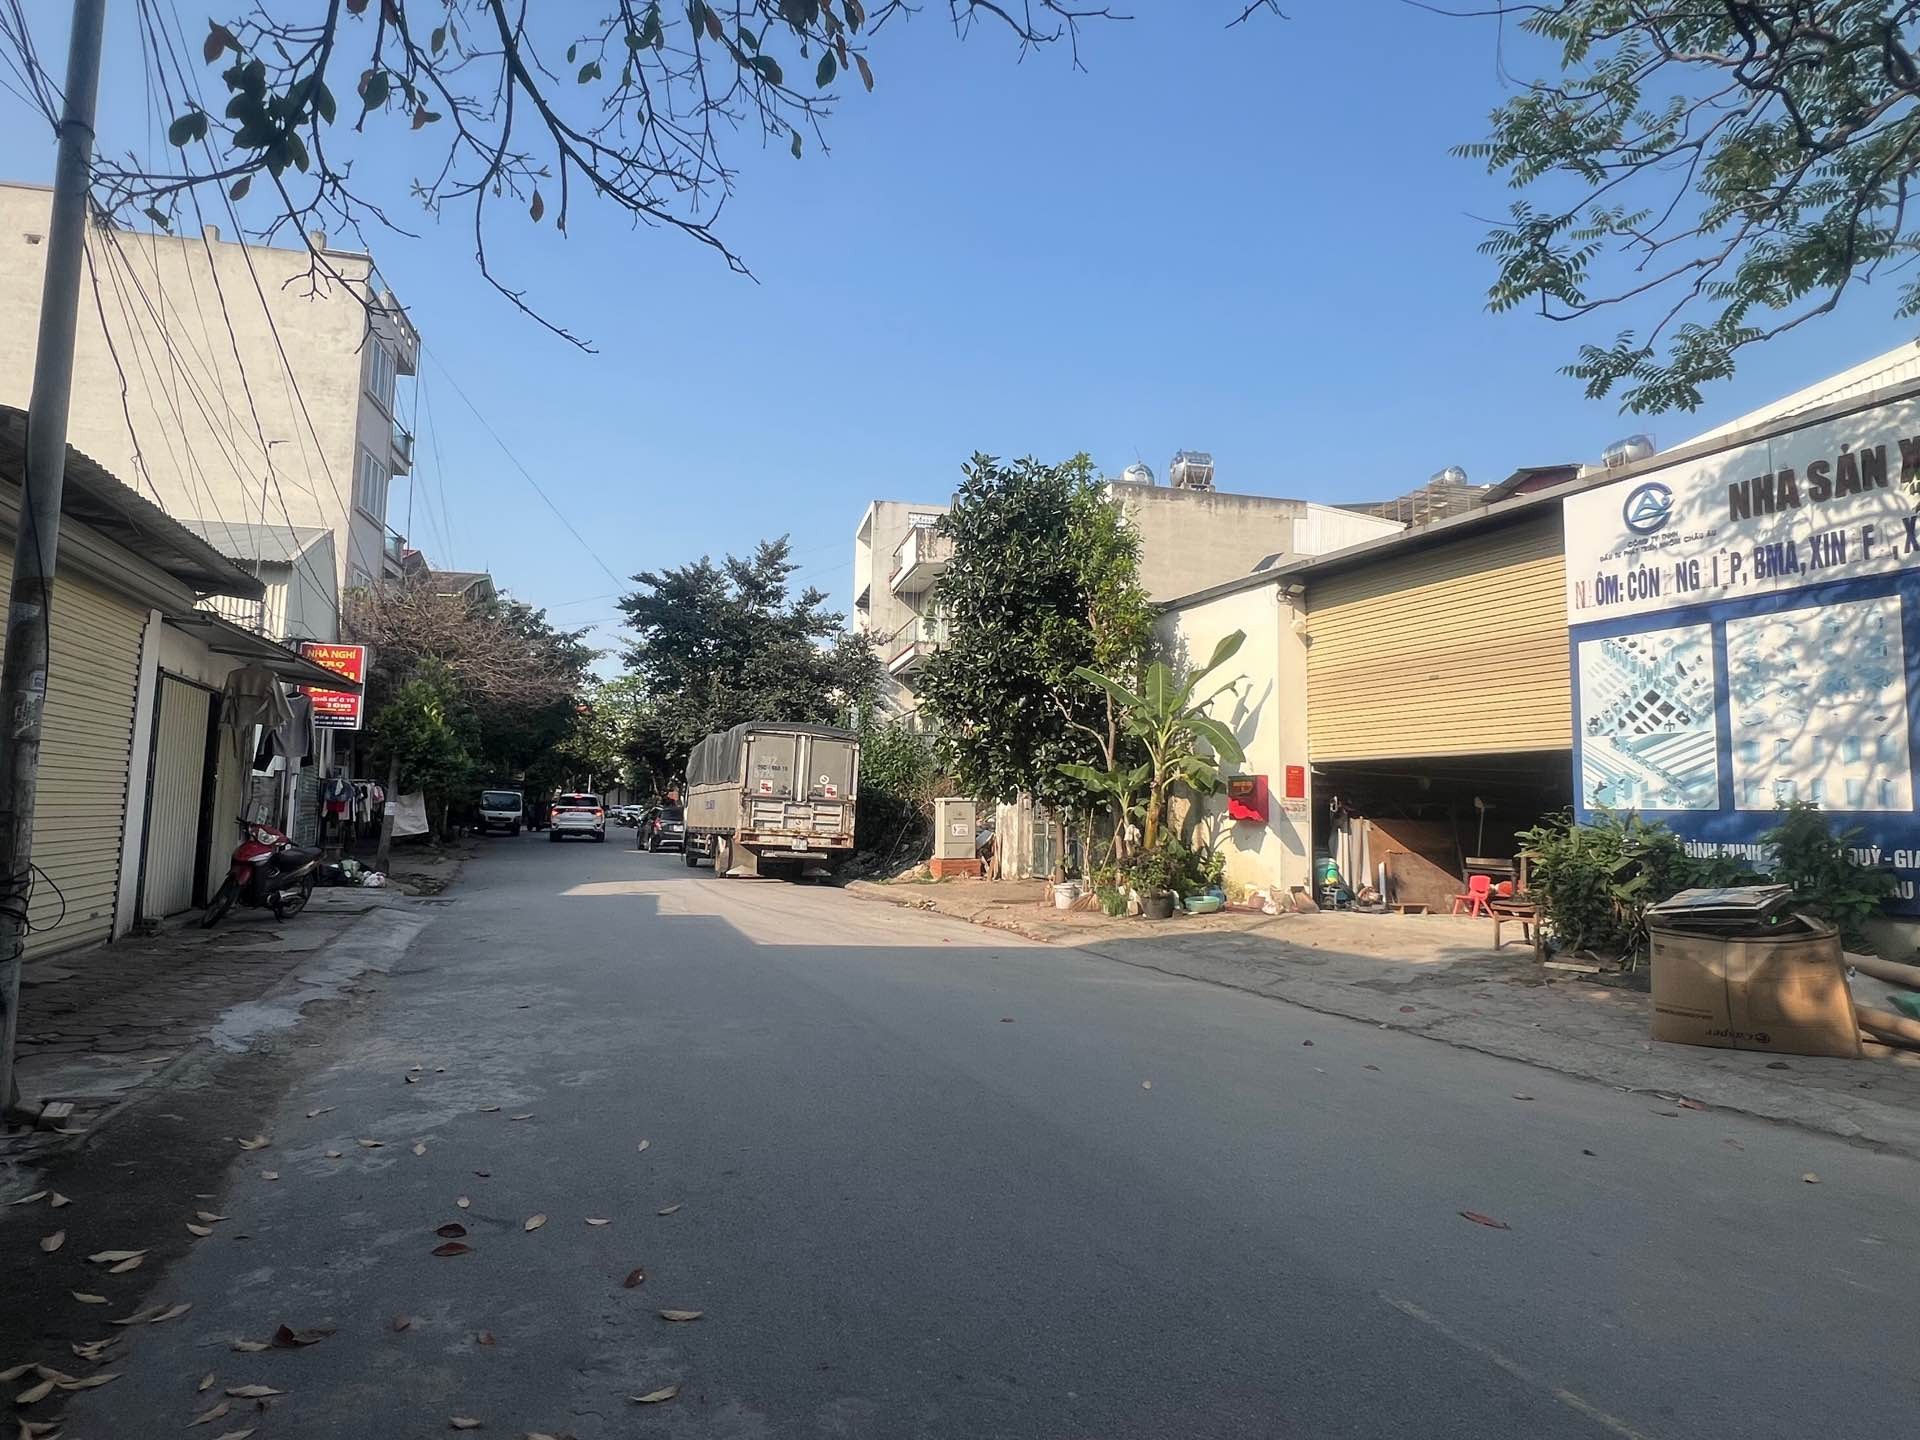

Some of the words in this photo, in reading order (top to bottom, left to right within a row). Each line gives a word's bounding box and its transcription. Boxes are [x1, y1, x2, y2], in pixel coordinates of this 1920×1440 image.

[1806, 443, 1889, 502] SẢN
[307, 649, 329, 658] NHÀ
[331, 650, 356, 659] NGHỈ
